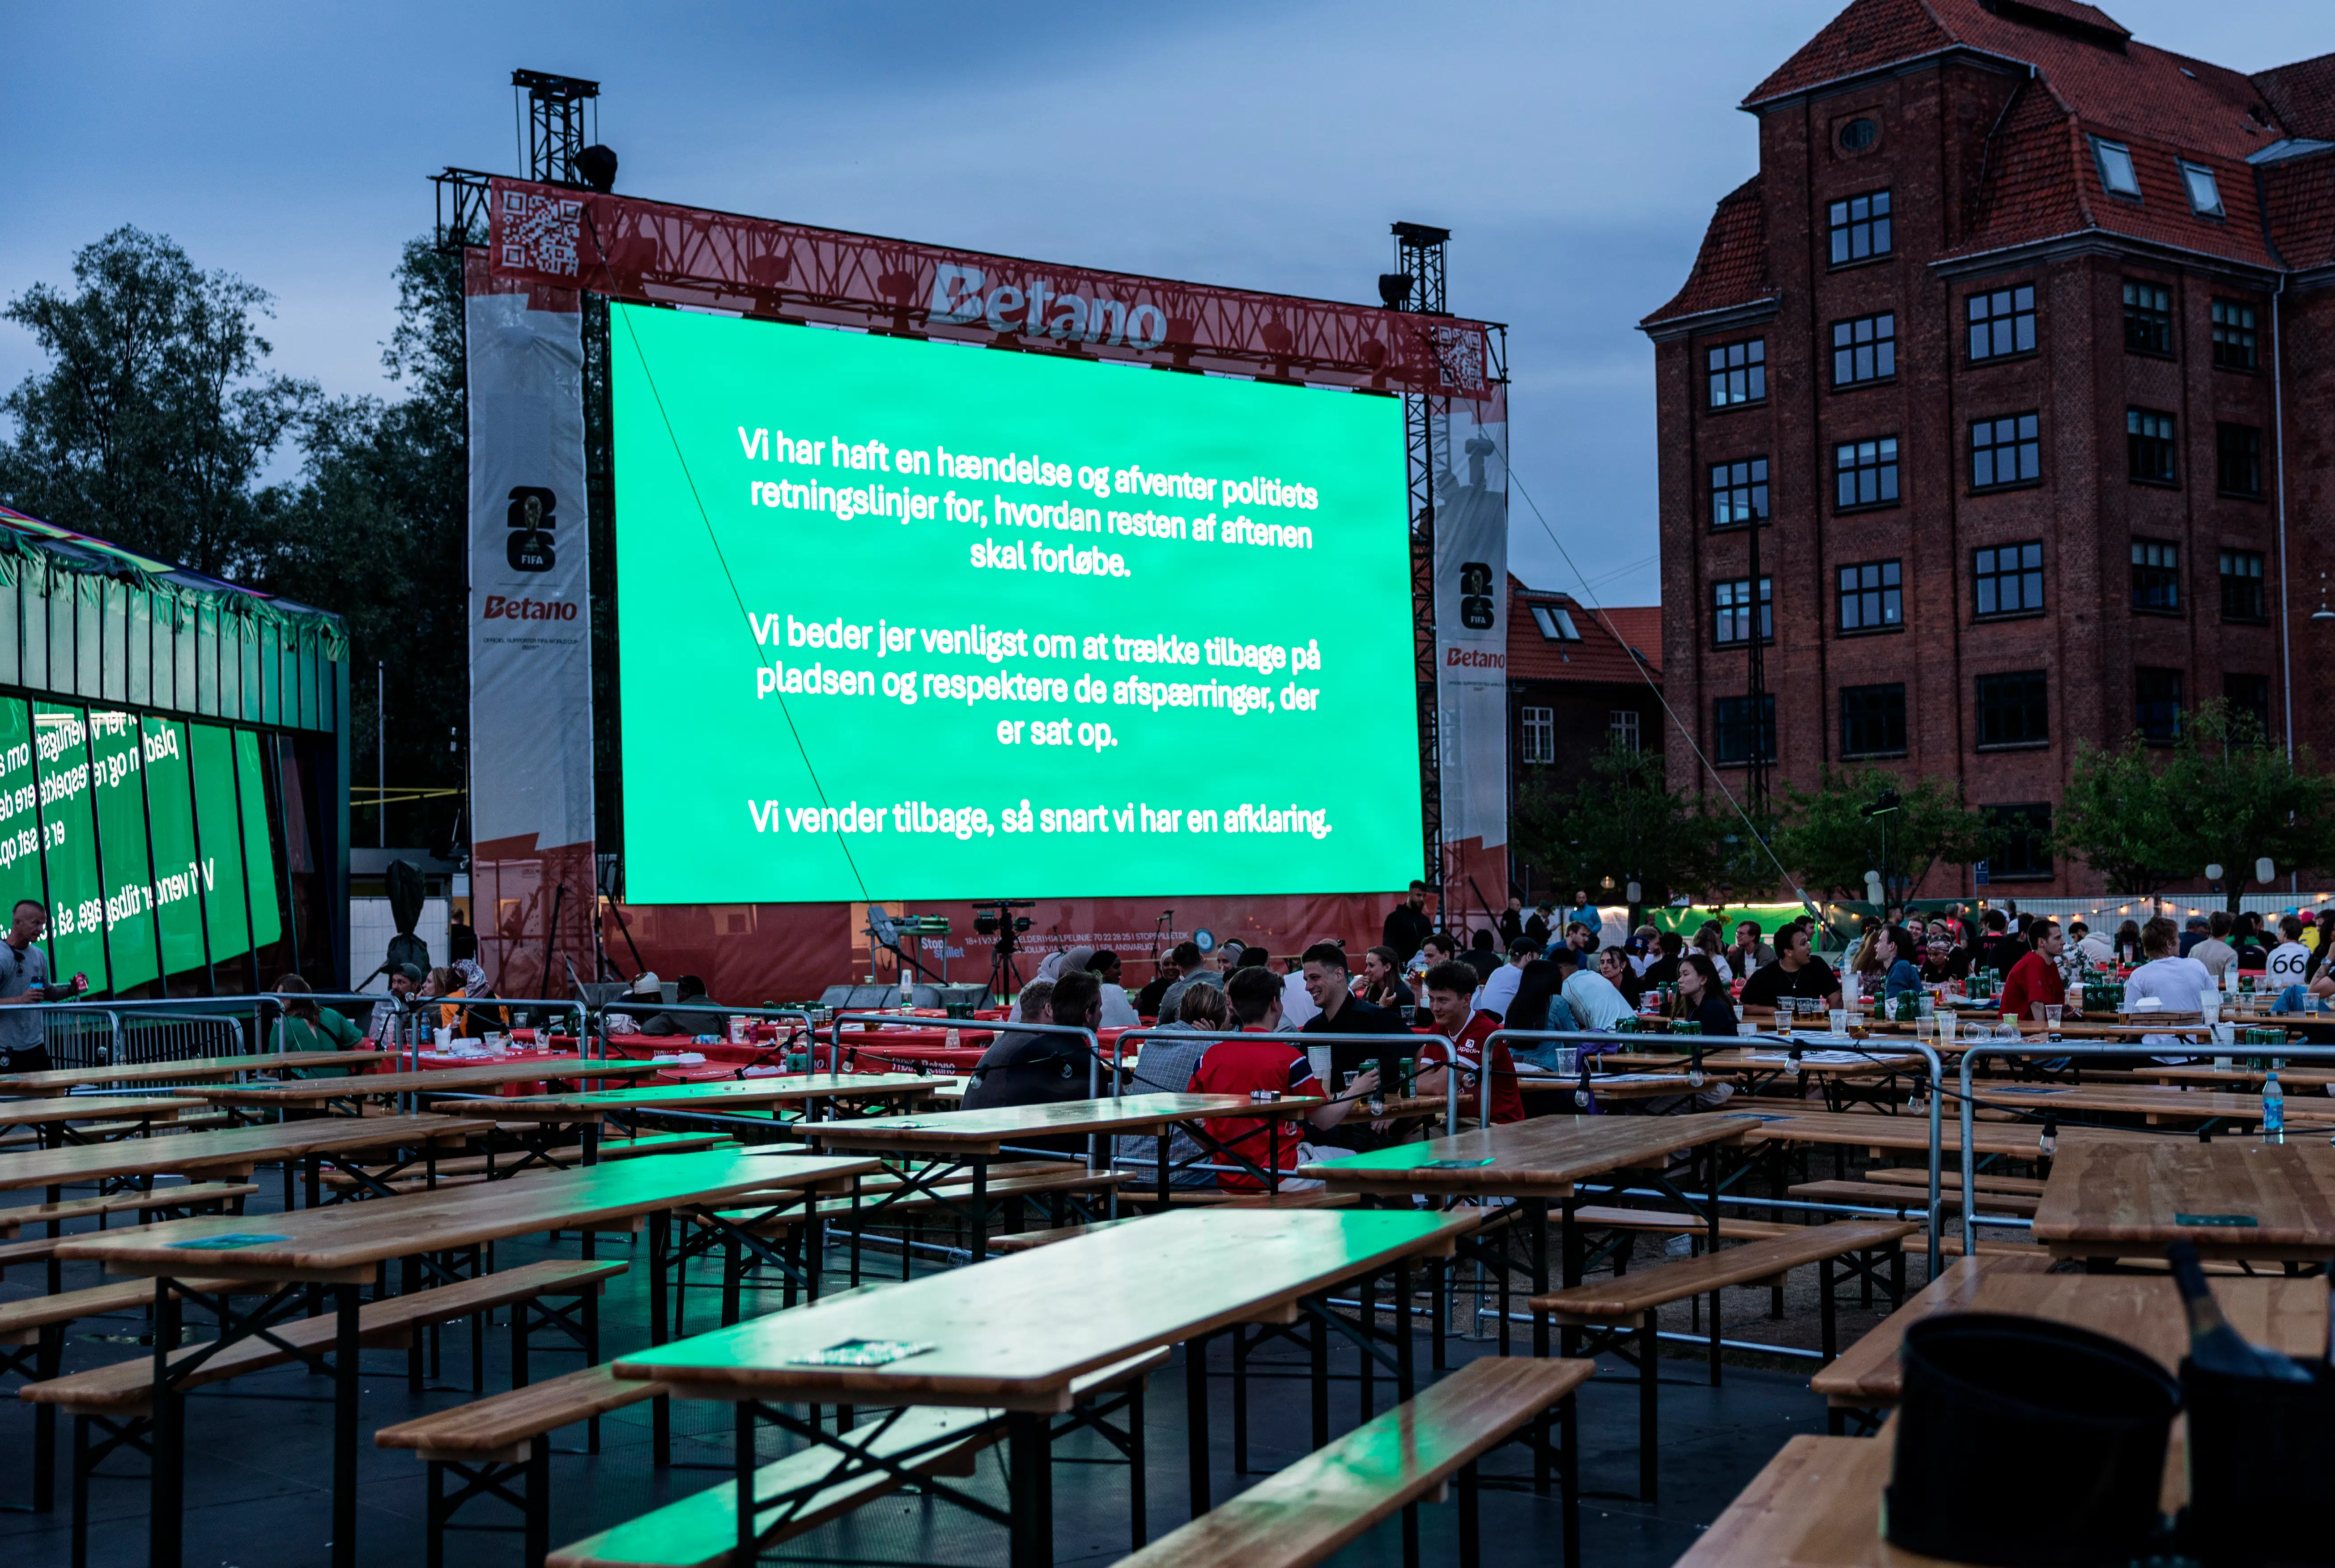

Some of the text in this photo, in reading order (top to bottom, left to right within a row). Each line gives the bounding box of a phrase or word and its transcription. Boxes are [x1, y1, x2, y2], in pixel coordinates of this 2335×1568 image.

[927, 263, 1167, 350] Betano
[738, 426, 1318, 510] Vi har haft en hændelse og afventer politiets
[752, 479, 1312, 549] retningslinjer for, hvordan resten af aftenen
[522, 554, 543, 565] FIFA
[970, 538, 1131, 577] skal forløbe.
[483, 595, 577, 621] Betano
[1470, 615, 1486, 625] FIFA
[749, 612, 1321, 676] Vi beder jer venligst om at trække tilbage på
[1447, 648, 1505, 668] Betano
[757, 660, 1320, 715] pladsen og respektere de afspærringer, der
[997, 718, 1118, 753] er sat op.
[748, 799, 1332, 840] Vi vender tilbage, så snart vi har en afklaring.
[921, 937, 944, 949] Stop
[965, 937, 977, 945] 18+
[2273, 954, 2305, 974] 66
